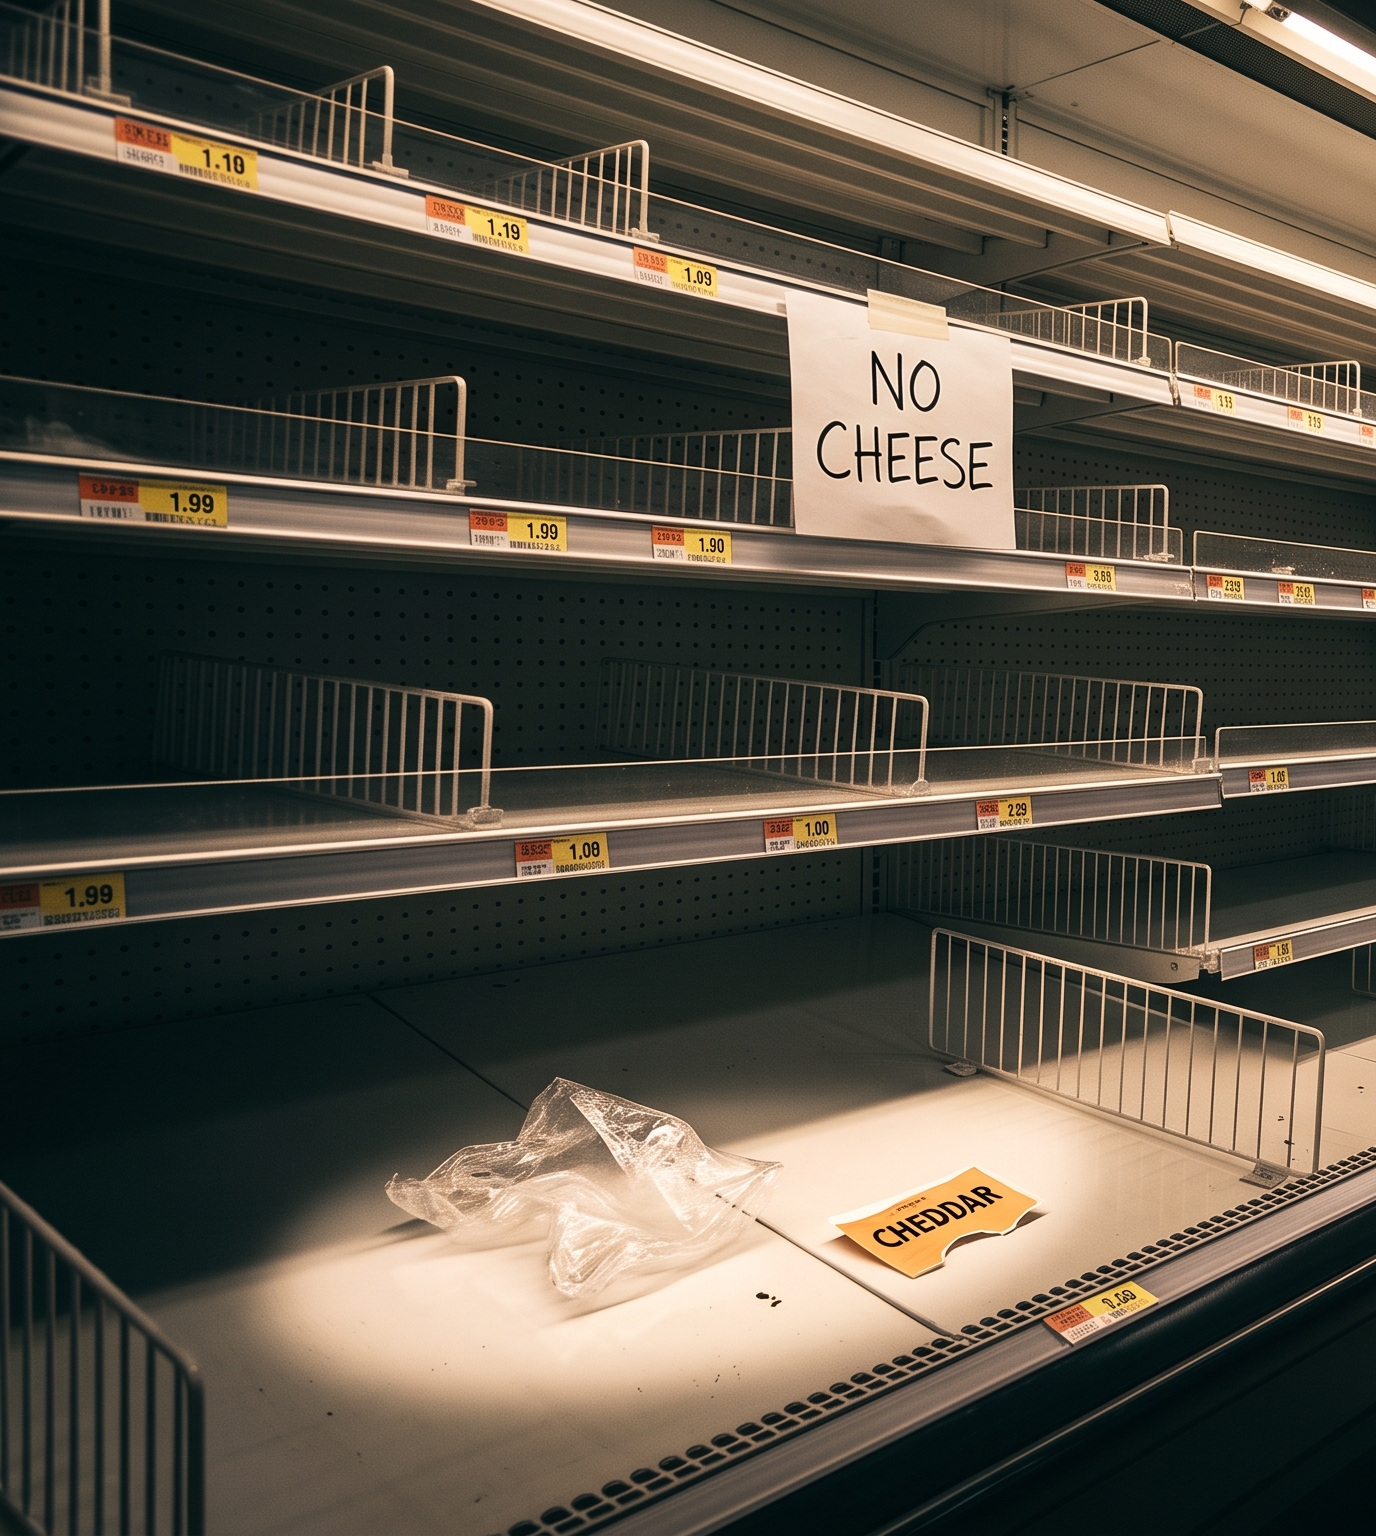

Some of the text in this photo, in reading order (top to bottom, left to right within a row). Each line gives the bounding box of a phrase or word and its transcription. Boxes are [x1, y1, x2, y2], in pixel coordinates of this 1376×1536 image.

[487, 218, 520, 240] 1.19
[684, 266, 713, 286] 1.09
[871, 350, 941, 412] NO
[816, 420, 994, 491] CHEESE
[170, 492, 214, 514] 1.99
[527, 522, 558, 540] 1.99
[698, 537, 725, 553] 1.90
[804, 820, 830, 837] 1.00
[65, 884, 113, 907] 1.99
[872, 1186, 1004, 1248] CHEDDAR
